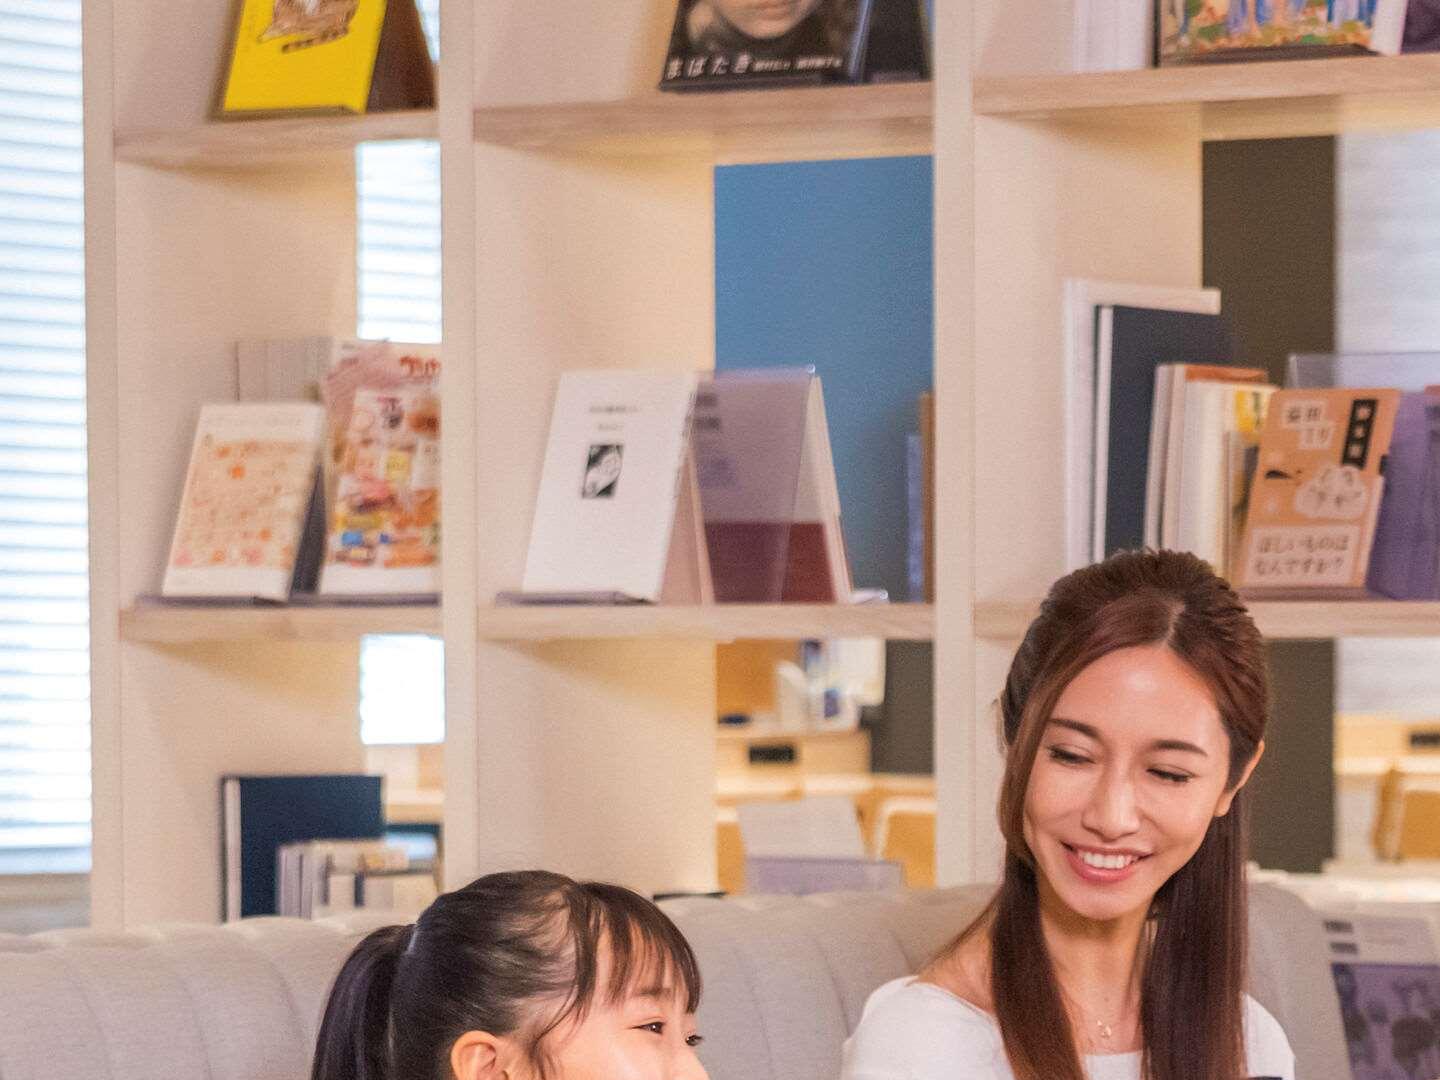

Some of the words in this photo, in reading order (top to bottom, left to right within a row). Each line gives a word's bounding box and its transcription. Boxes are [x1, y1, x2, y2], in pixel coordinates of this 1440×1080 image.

[1258, 535, 1350, 553] ほしいものは
